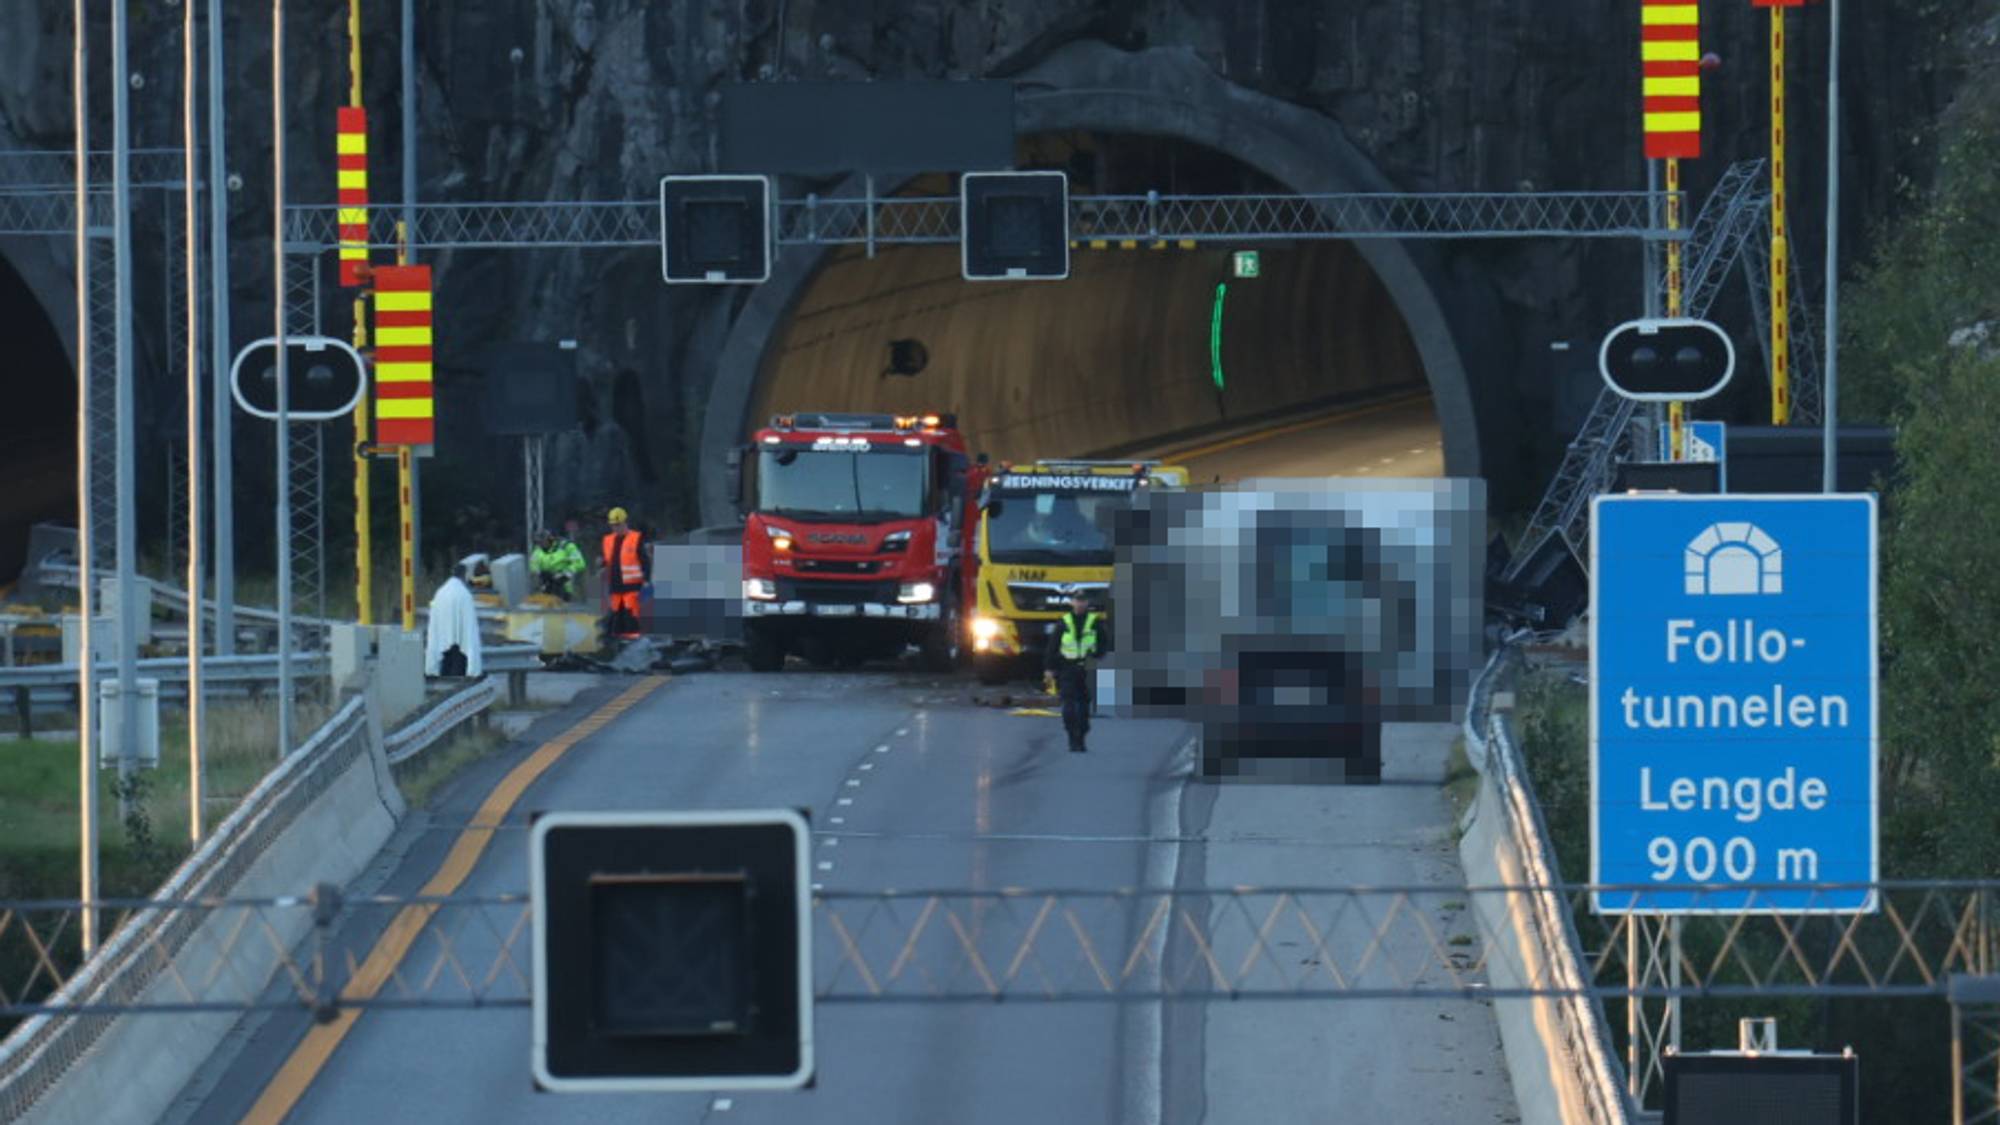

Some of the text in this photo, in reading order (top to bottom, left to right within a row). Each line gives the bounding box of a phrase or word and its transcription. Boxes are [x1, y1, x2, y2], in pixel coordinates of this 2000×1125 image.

[1018, 568, 1048, 581] NAF
[1666, 619, 1806, 663] Follo-
[1621, 684, 1848, 728] tunnelen
[1640, 766, 1828, 822] Lengde
[1647, 836, 1818, 881] 900 m
